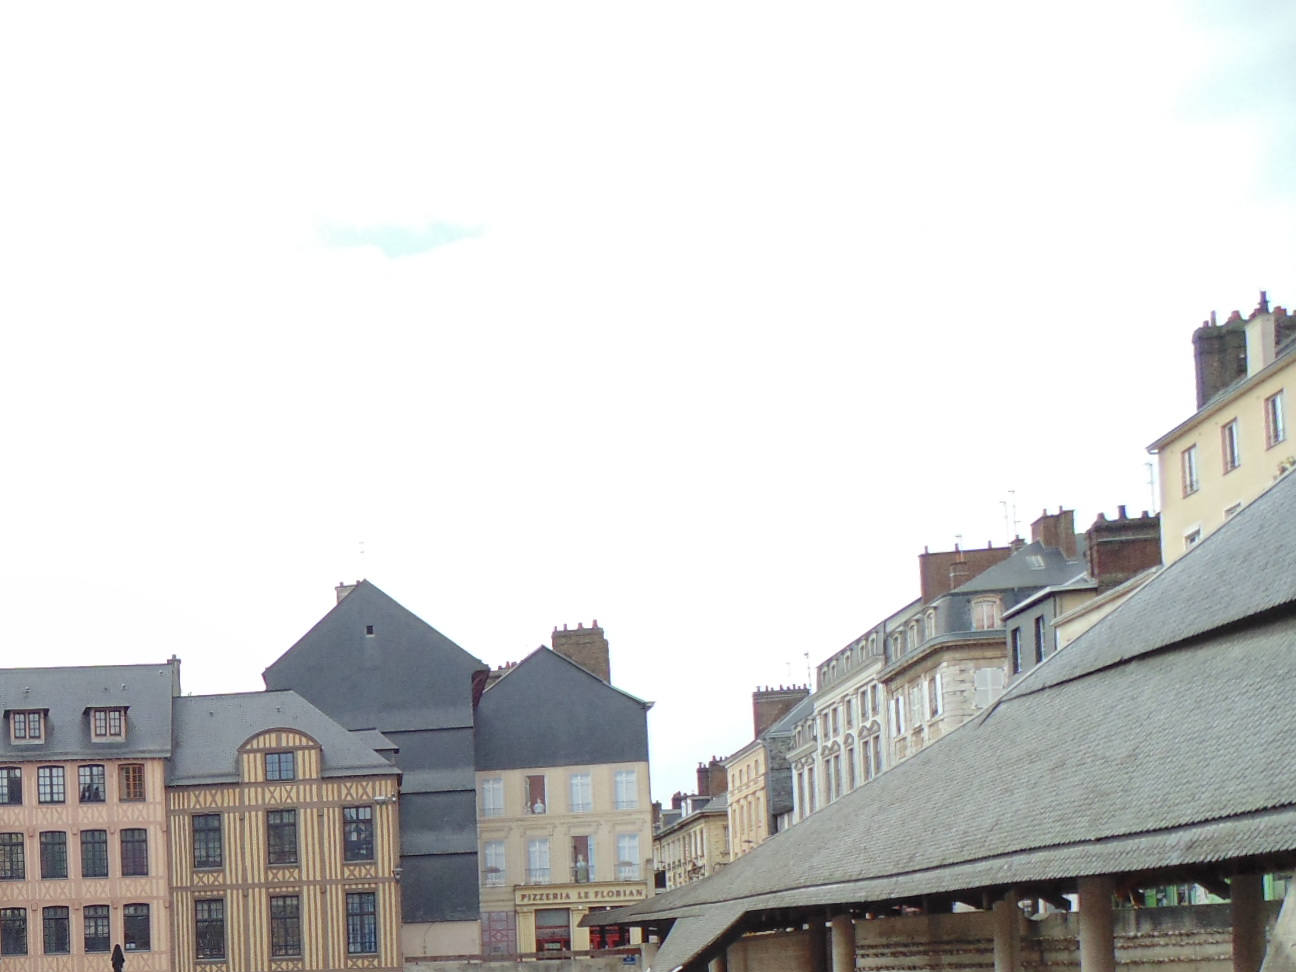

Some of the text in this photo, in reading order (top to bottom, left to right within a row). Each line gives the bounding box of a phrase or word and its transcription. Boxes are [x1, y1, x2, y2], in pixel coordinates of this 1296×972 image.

[520, 888, 643, 901] PIZZERIA LE FLORIAN
